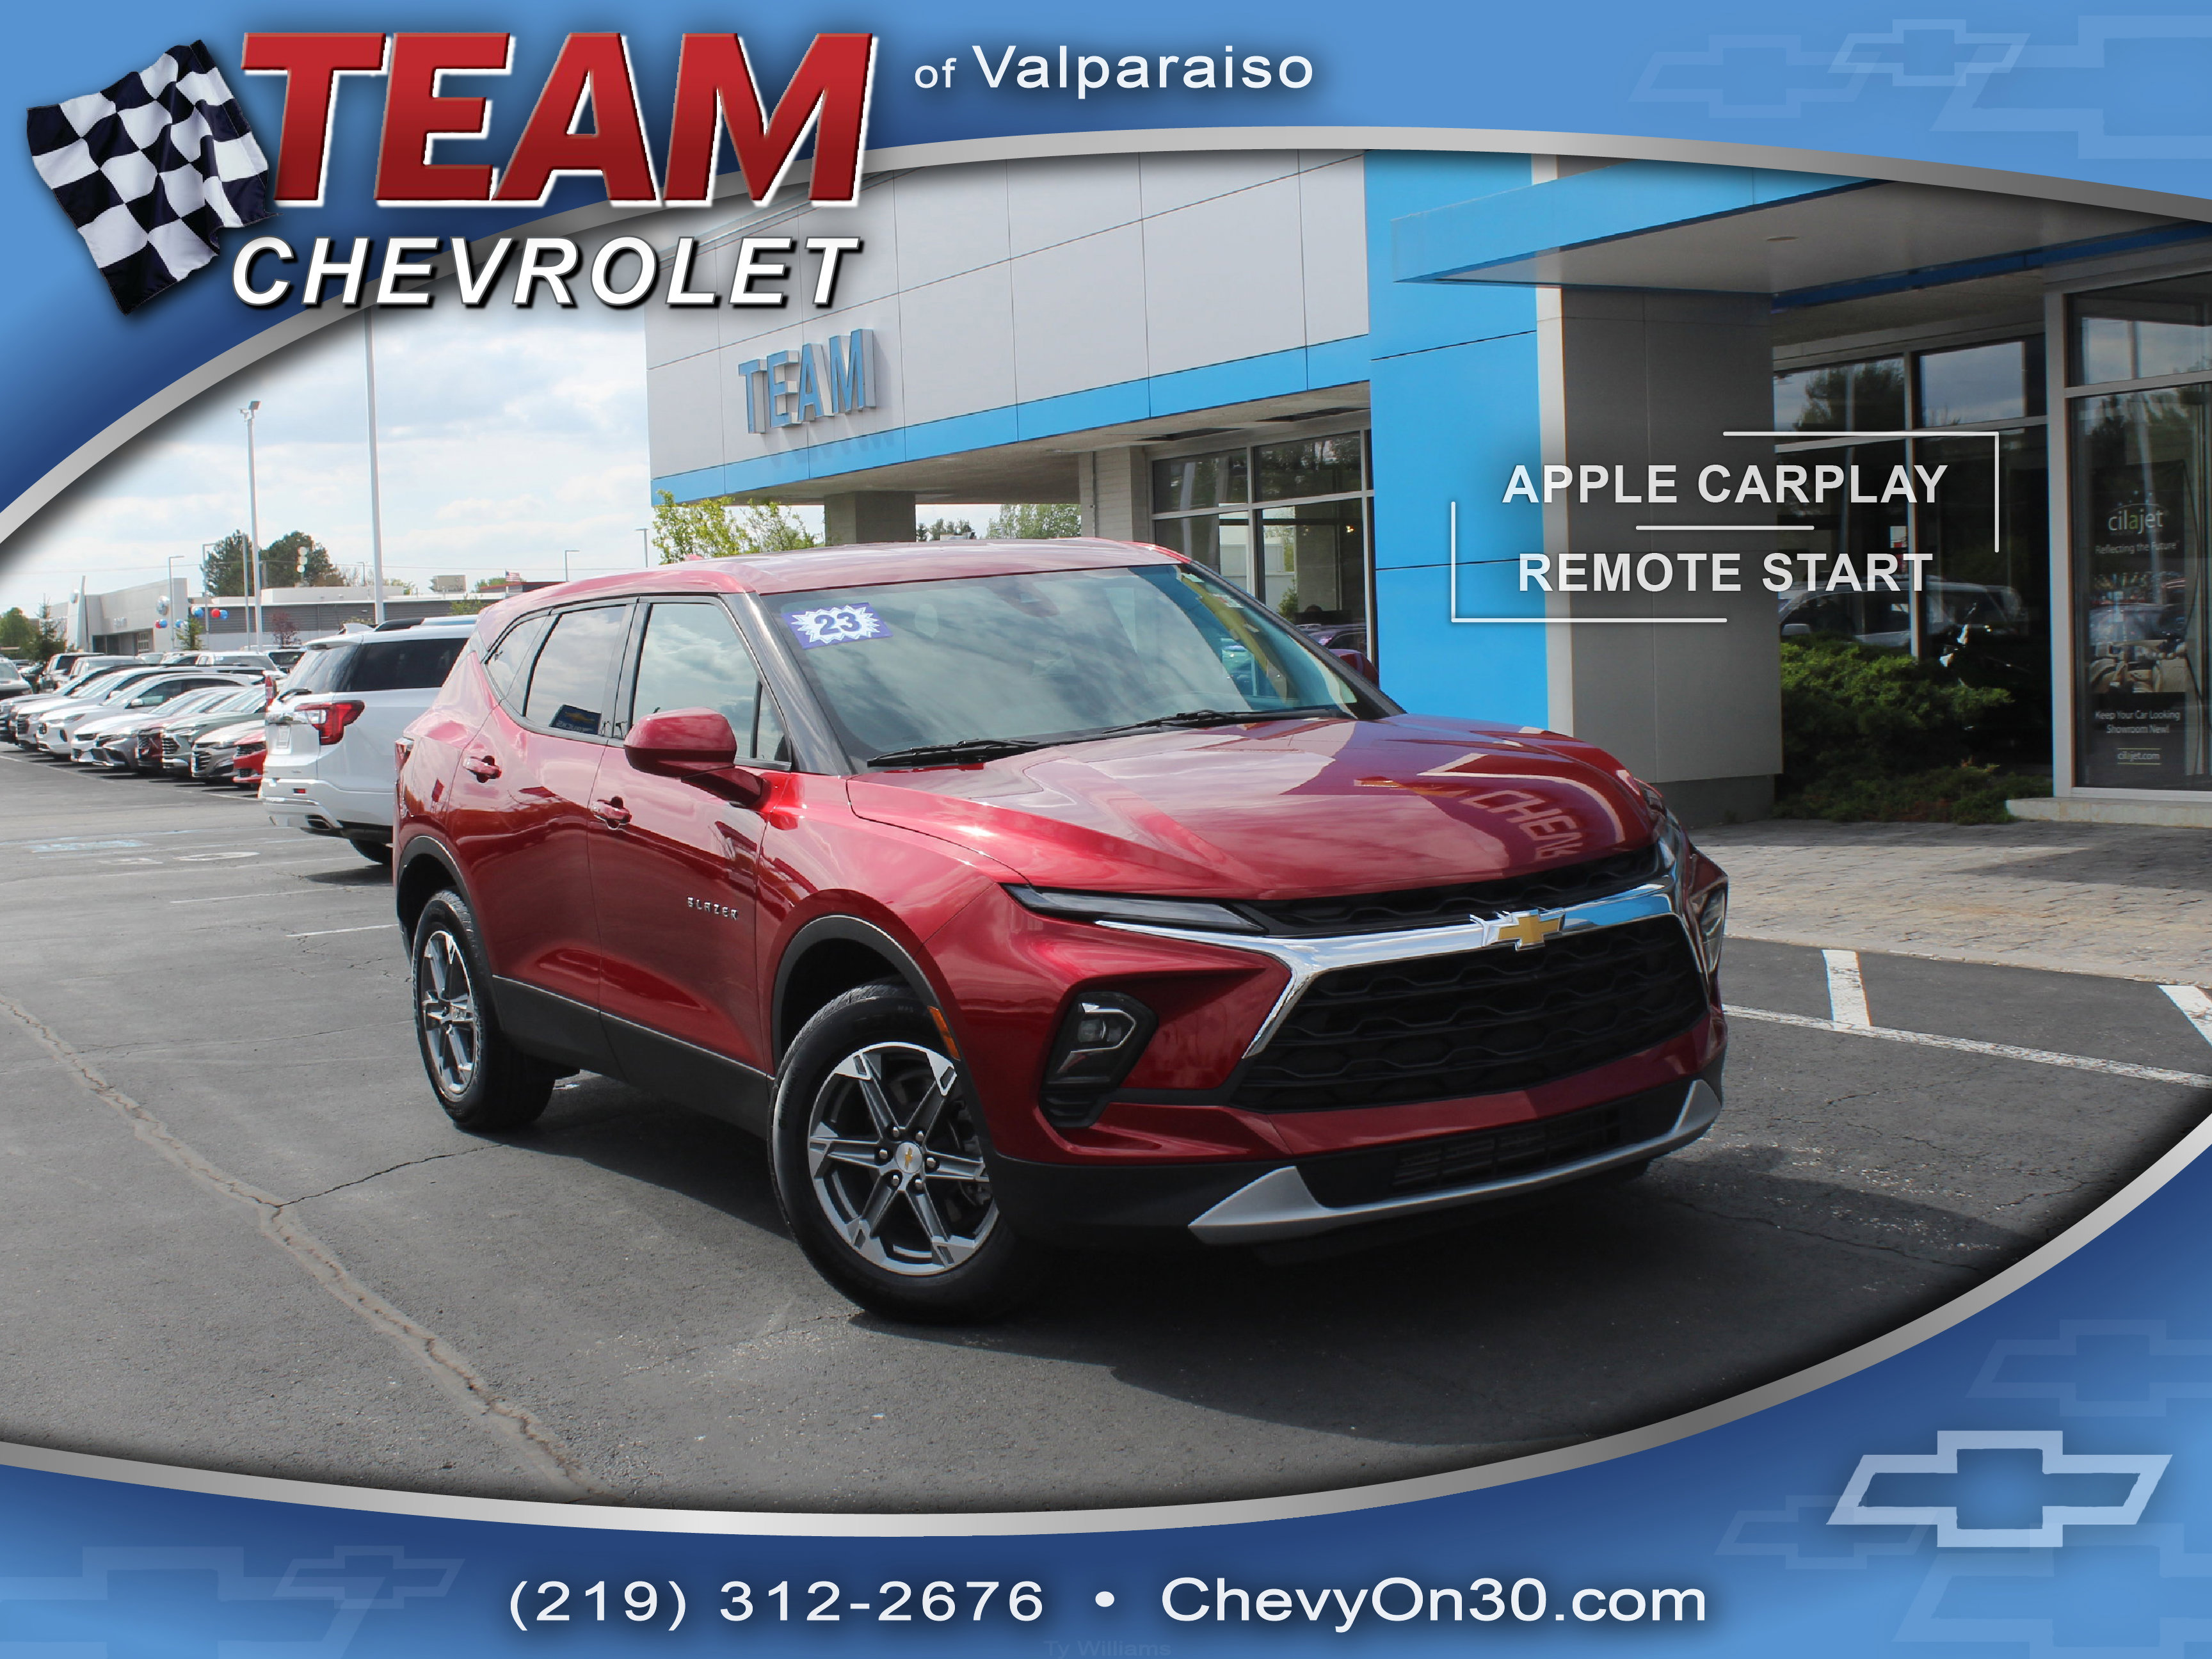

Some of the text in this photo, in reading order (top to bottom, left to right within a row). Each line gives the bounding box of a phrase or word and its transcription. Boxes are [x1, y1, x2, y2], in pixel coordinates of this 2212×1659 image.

[738, 328, 876, 434] TEAM
[2108, 509, 2164, 534] cilajet
[814, 612, 862, 636] 23
[2095, 712, 2116, 720] Keep
[2135, 710, 2148, 719] Car
[2149, 710, 2181, 721] Looking
[2106, 725, 2148, 733] Showroom
[687, 896, 738, 920] BLAZER
